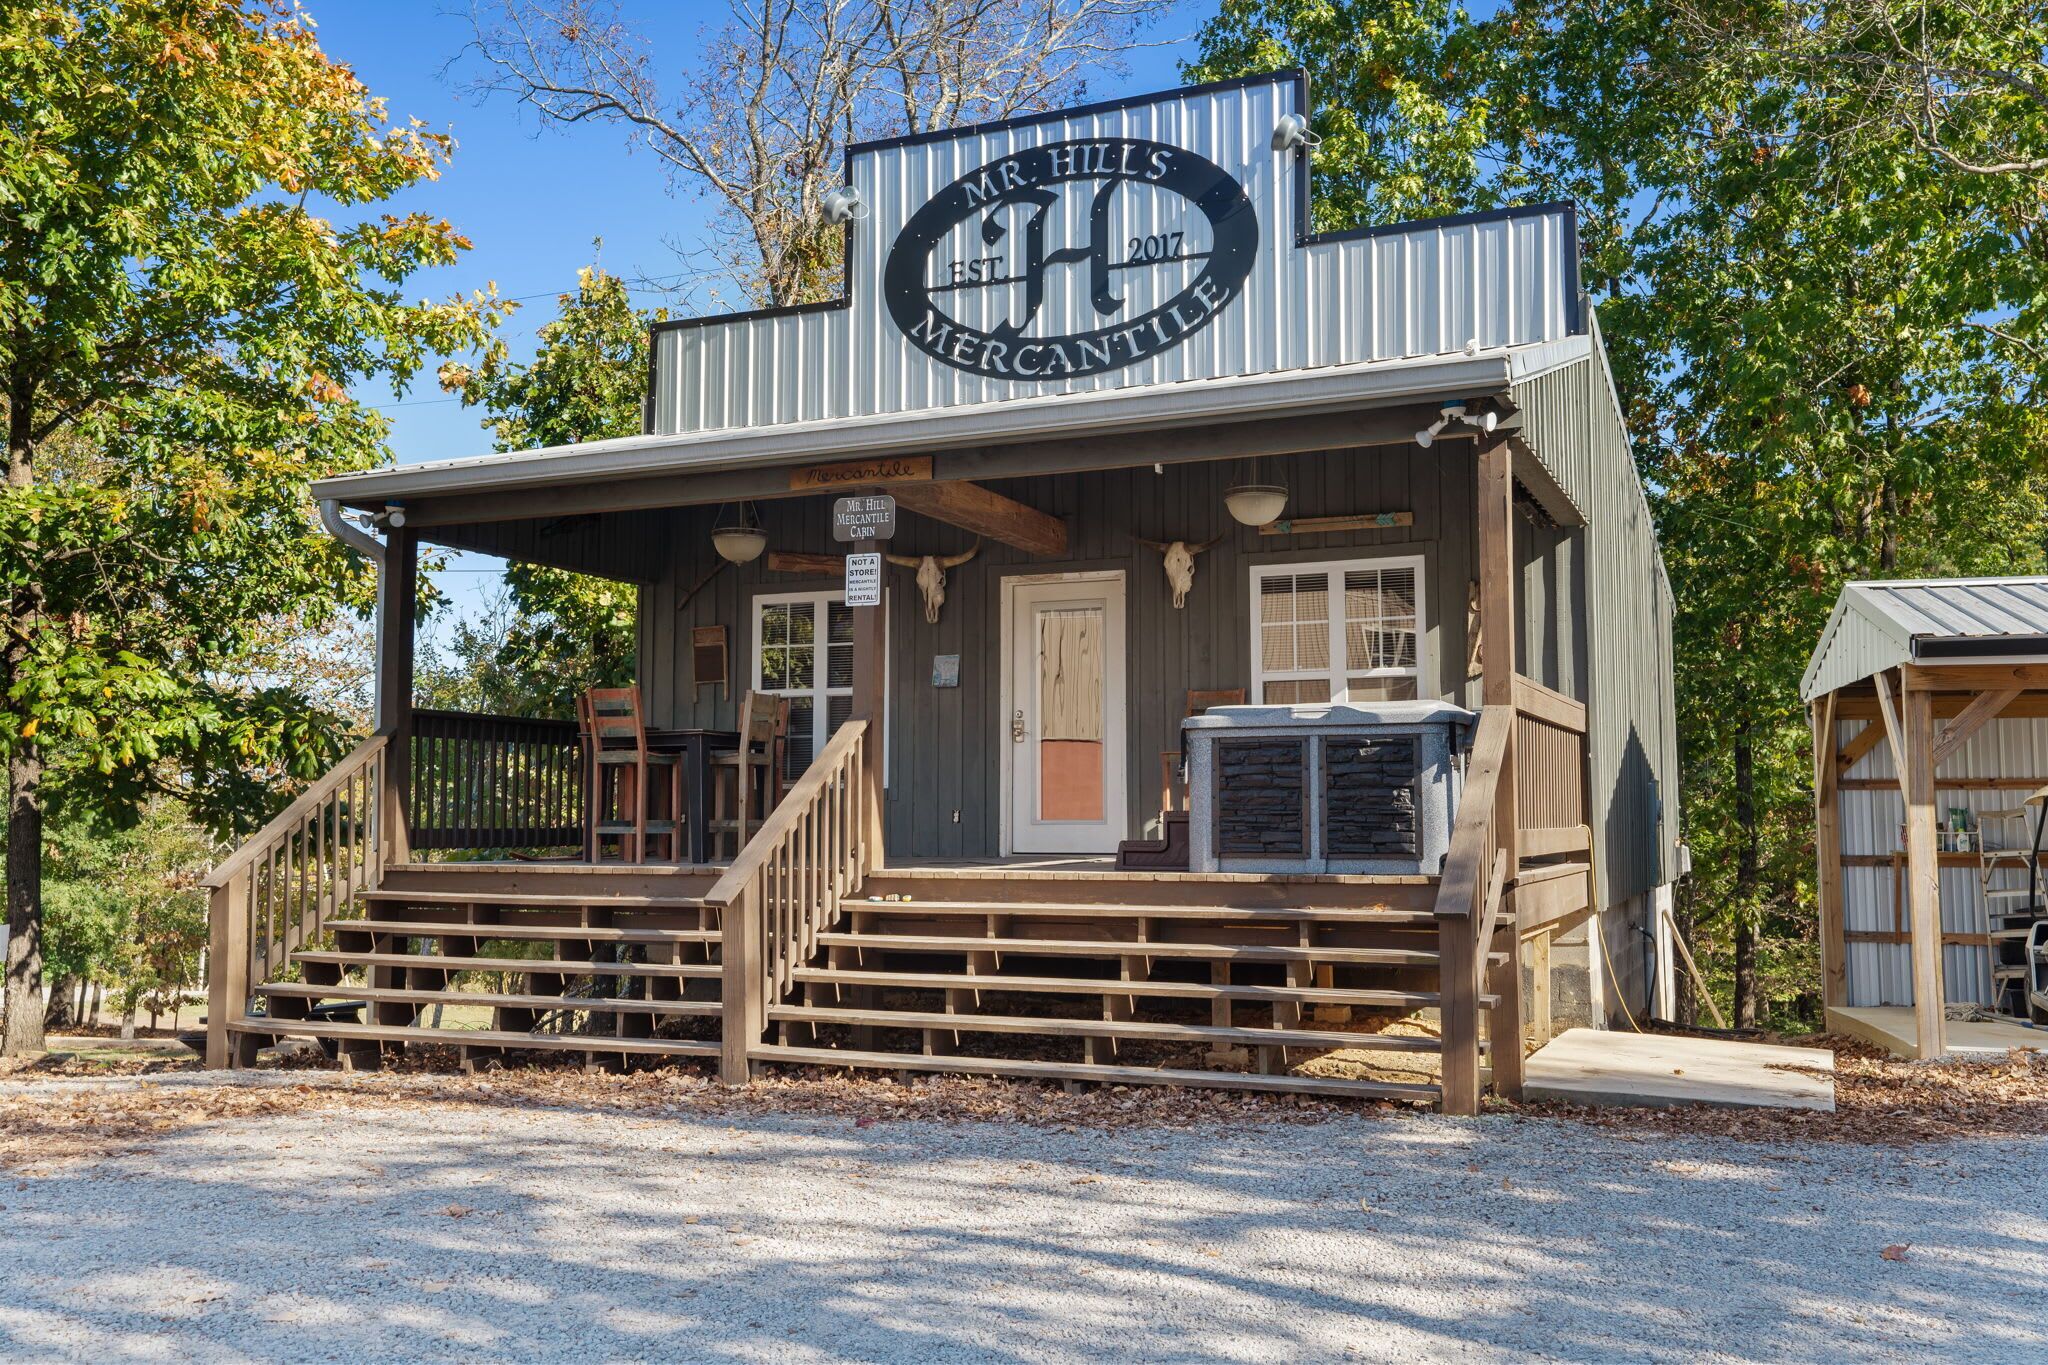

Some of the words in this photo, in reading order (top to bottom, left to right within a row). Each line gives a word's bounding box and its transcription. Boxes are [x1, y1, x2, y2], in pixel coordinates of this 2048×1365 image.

[960, 159, 1037, 209] MR.
[1047, 143, 1173, 180] HILL'S
[1128, 231, 1184, 261] 2017
[948, 256, 1008, 284] EST.
[910, 275, 1230, 376] MERCANTILE
[866, 498, 886, 511] HILL
[837, 513, 889, 526] MERCANTILE
[850, 526, 876, 538] CABIN
[851, 558, 867, 566] NOT
[849, 568, 877, 576] STORE!
